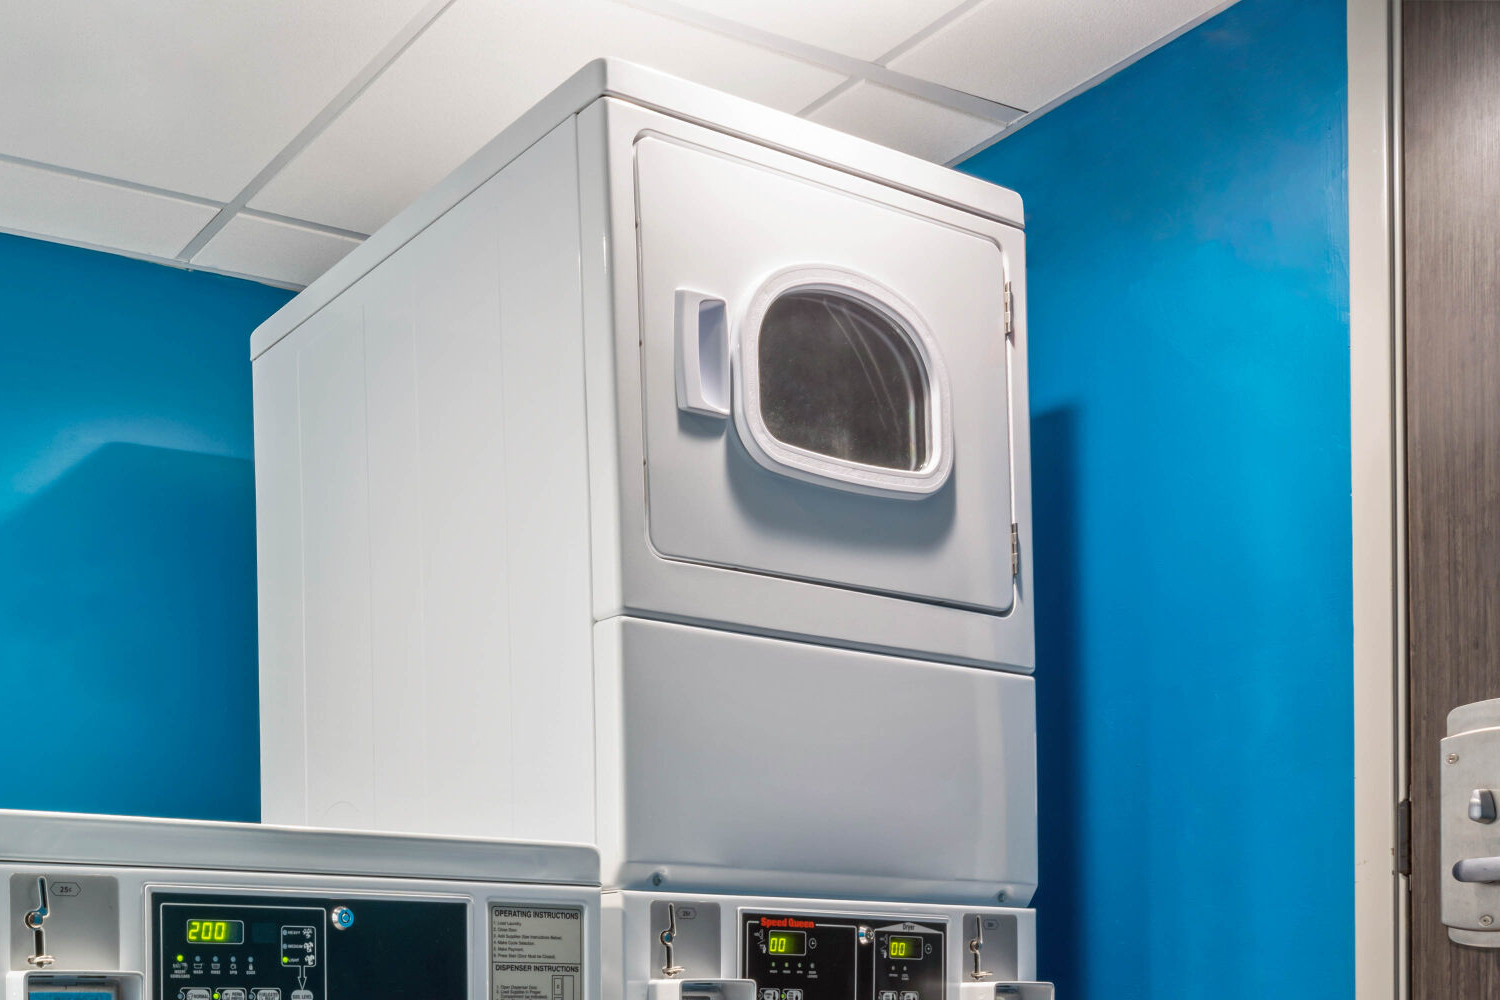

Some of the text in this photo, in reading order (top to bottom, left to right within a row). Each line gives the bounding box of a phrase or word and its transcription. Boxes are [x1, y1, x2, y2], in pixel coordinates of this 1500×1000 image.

[494, 910, 579, 920] OPERATING INSTRUCTIONS
[760, 917, 815, 928] Speed Queen
[902, 924, 915, 932] Dryer
[188, 922, 226, 940] 200
[770, 938, 786, 952] 00
[890, 942, 906, 956] 00
[495, 964, 532, 972] DISPENSER
